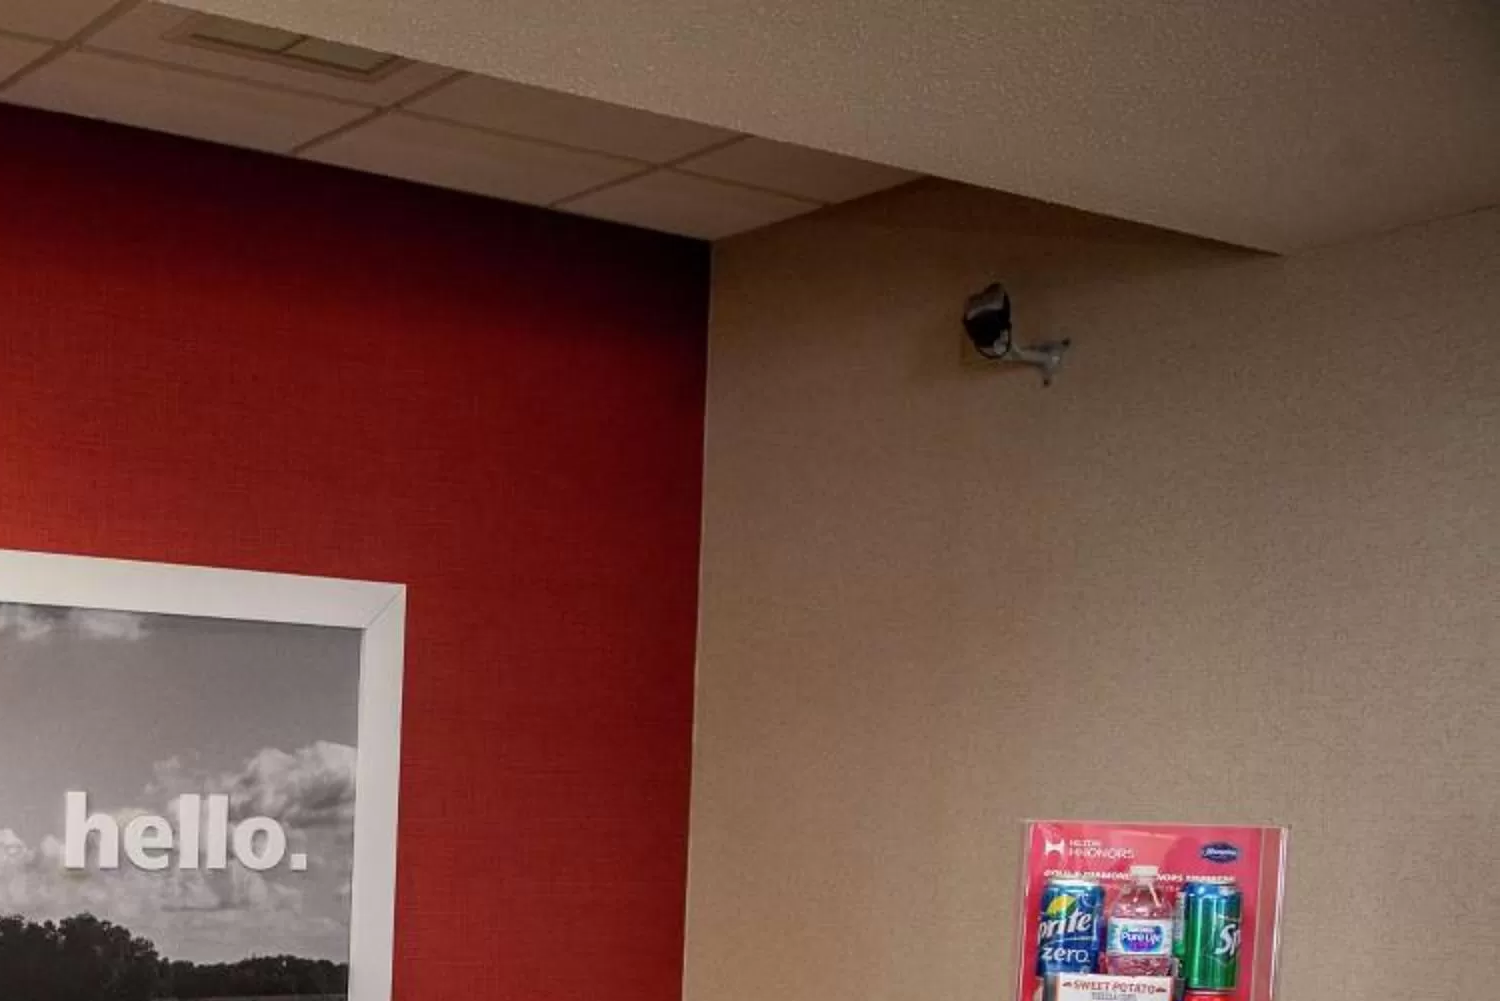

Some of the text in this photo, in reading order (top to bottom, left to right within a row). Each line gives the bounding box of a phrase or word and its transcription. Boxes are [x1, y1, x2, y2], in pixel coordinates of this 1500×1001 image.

[64, 791, 308, 870] hello.
[1038, 908, 1092, 941] prite
[1041, 946, 1090, 962] zero
[1074, 980, 1156, 994] SWEET POTATO
